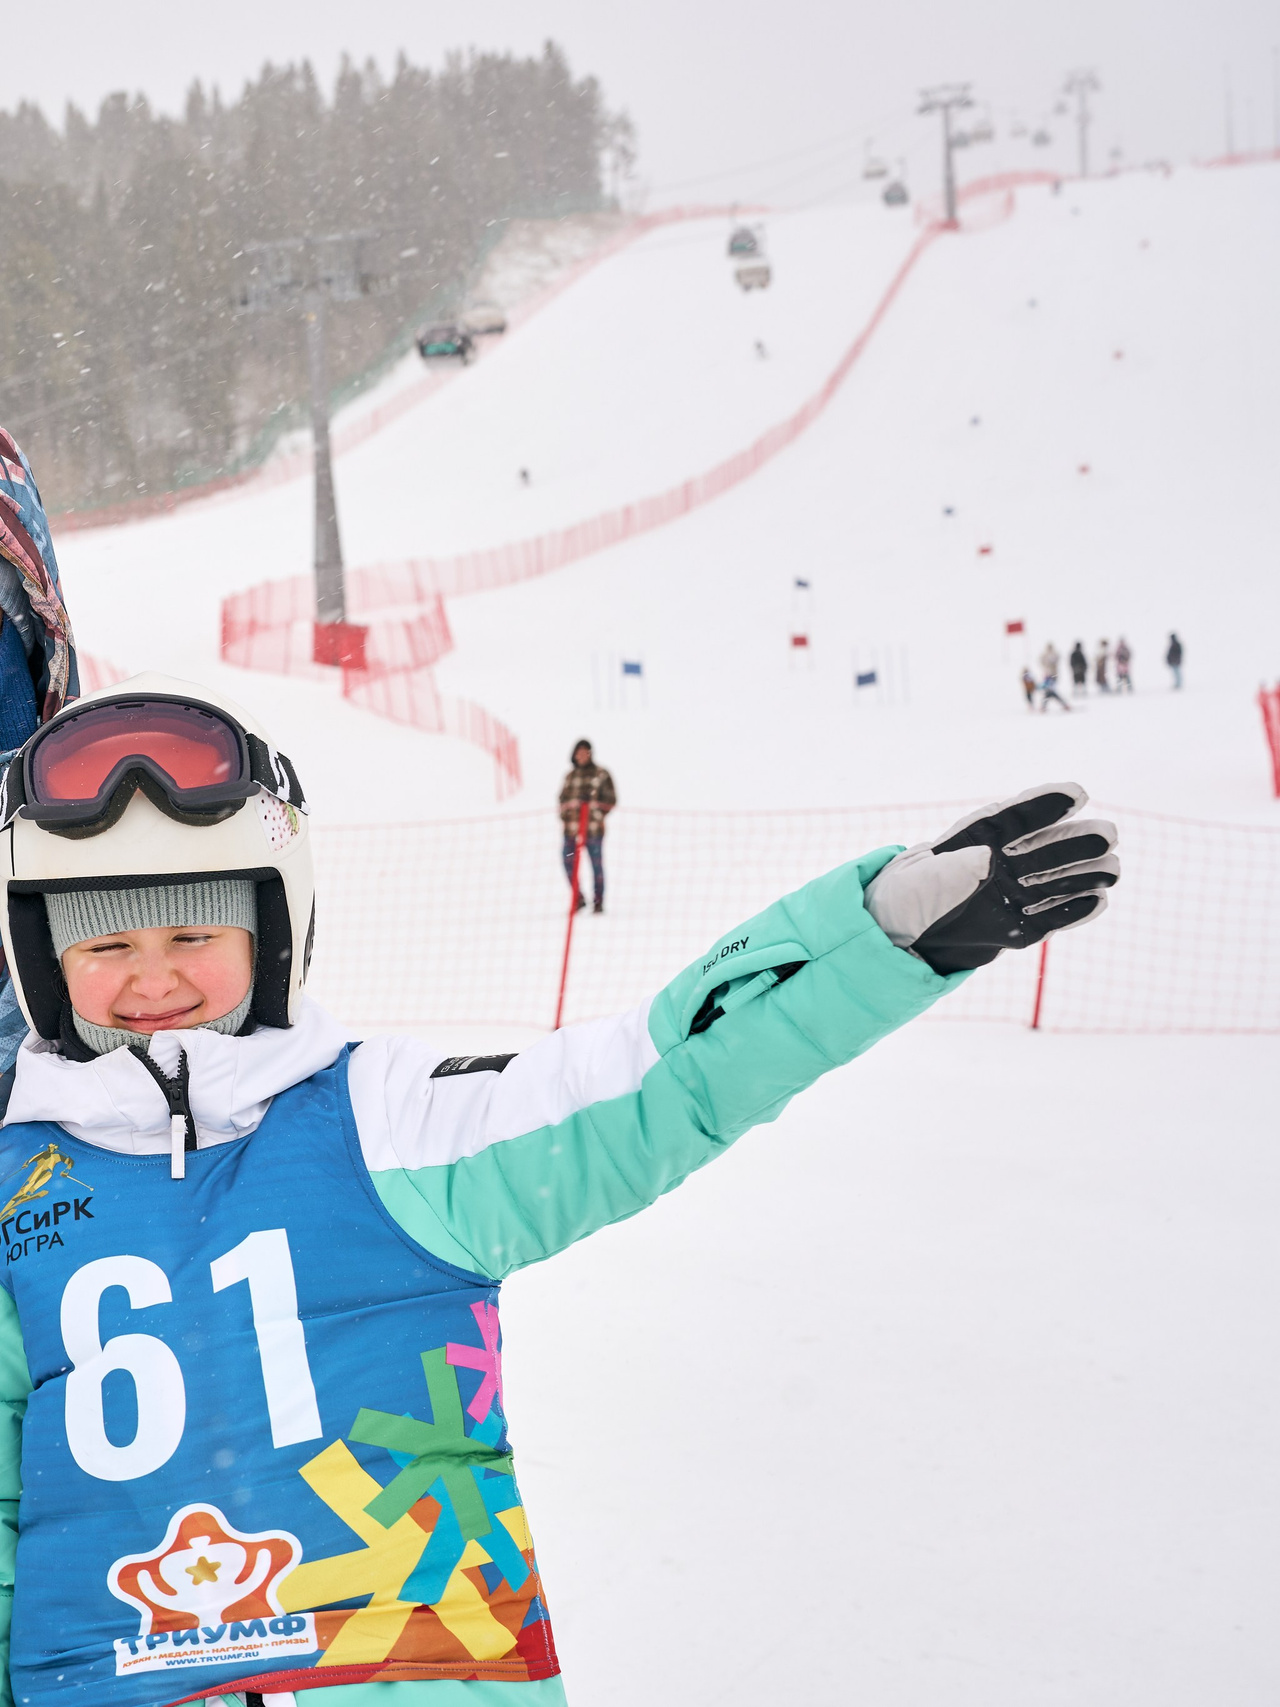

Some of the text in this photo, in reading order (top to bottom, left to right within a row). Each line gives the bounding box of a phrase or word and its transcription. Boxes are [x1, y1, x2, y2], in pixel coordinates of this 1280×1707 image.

[721, 936, 749, 958] DRY
[6, 1231, 64, 1266] ЮГРА
[60, 1228, 323, 1481] 61
[121, 1614, 306, 1655] ТРИУМФ
[122, 1637, 309, 1668] КУБКИ МЕДАЛИ НАГРАДЫ ПРИЗЫ
[165, 1651, 260, 1666] WWW.TRYUMF.RU
